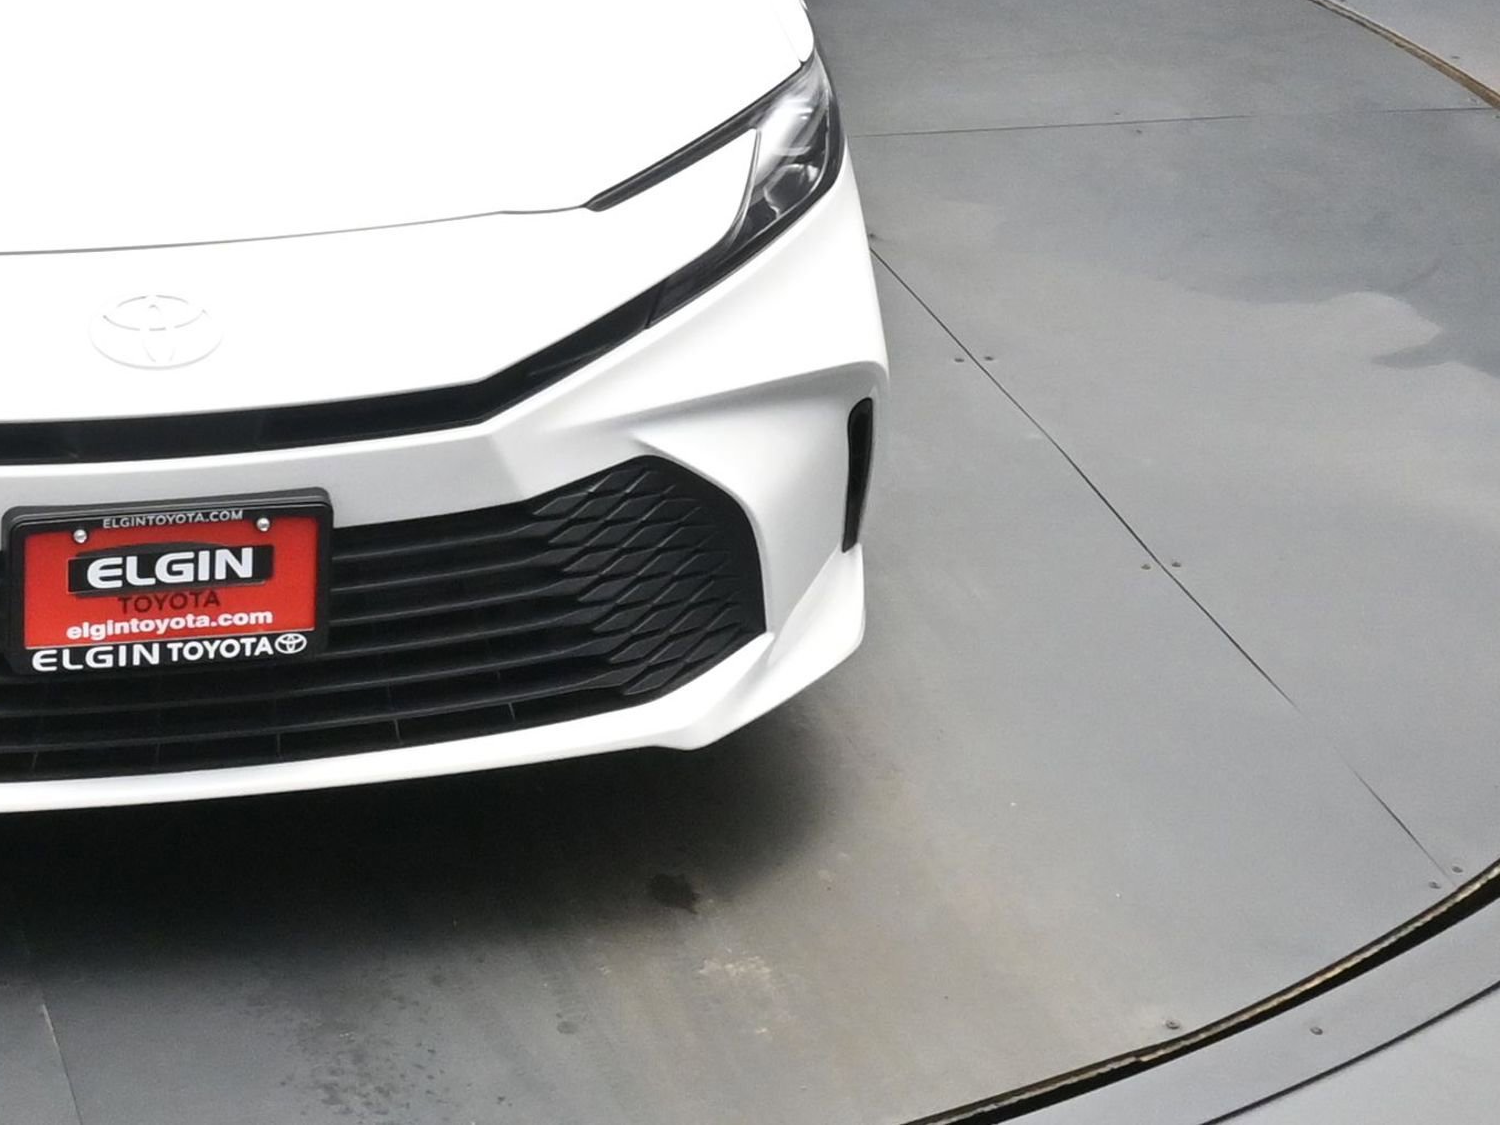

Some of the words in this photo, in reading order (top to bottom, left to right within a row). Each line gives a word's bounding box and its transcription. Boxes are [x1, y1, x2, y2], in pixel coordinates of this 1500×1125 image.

[102, 509, 244, 529] ELGINTOYOTA.COM
[86, 546, 254, 589] ELGIN
[118, 590, 221, 614] TOYOTA
[66, 610, 273, 640] elgintoyota.com
[32, 642, 160, 672] ELGIN
[166, 636, 274, 662] TOYOTA
